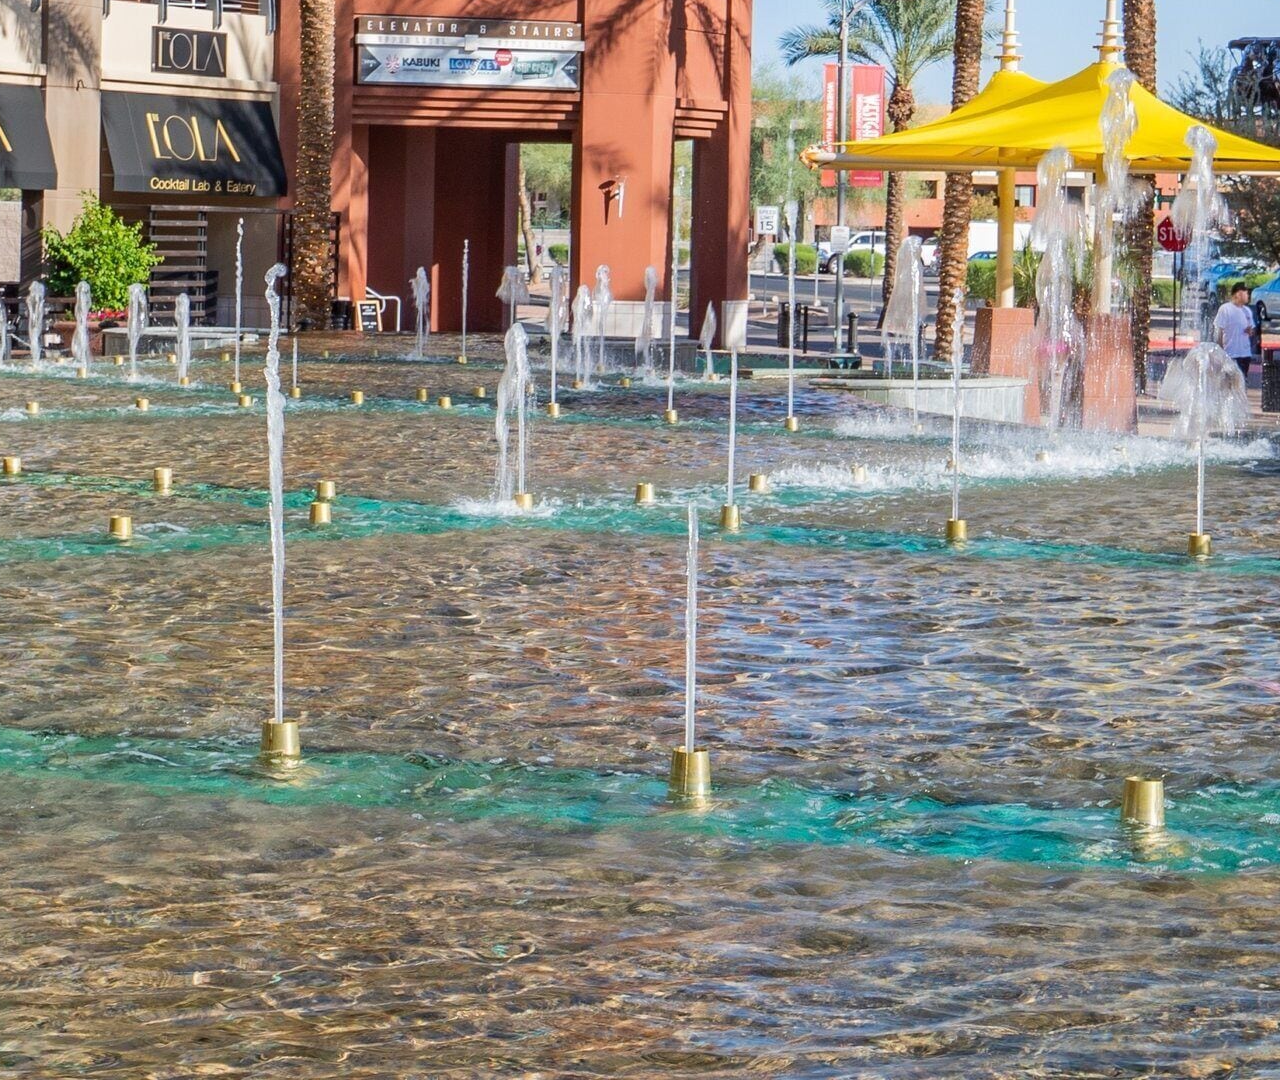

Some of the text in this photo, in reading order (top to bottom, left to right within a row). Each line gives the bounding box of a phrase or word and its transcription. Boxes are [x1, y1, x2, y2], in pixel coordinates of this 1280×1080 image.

[367, 20, 574, 37] ELEVATOR & STAIRS
[158, 31, 224, 73] LOLA
[402, 56, 440, 68] KABUKI
[826, 81, 836, 109] WHERE
[825, 111, 835, 129] FUN
[146, 112, 241, 163] LOLA
[149, 176, 257, 197] Cocktail Lab & Eatery
[760, 221, 774, 231] 15
